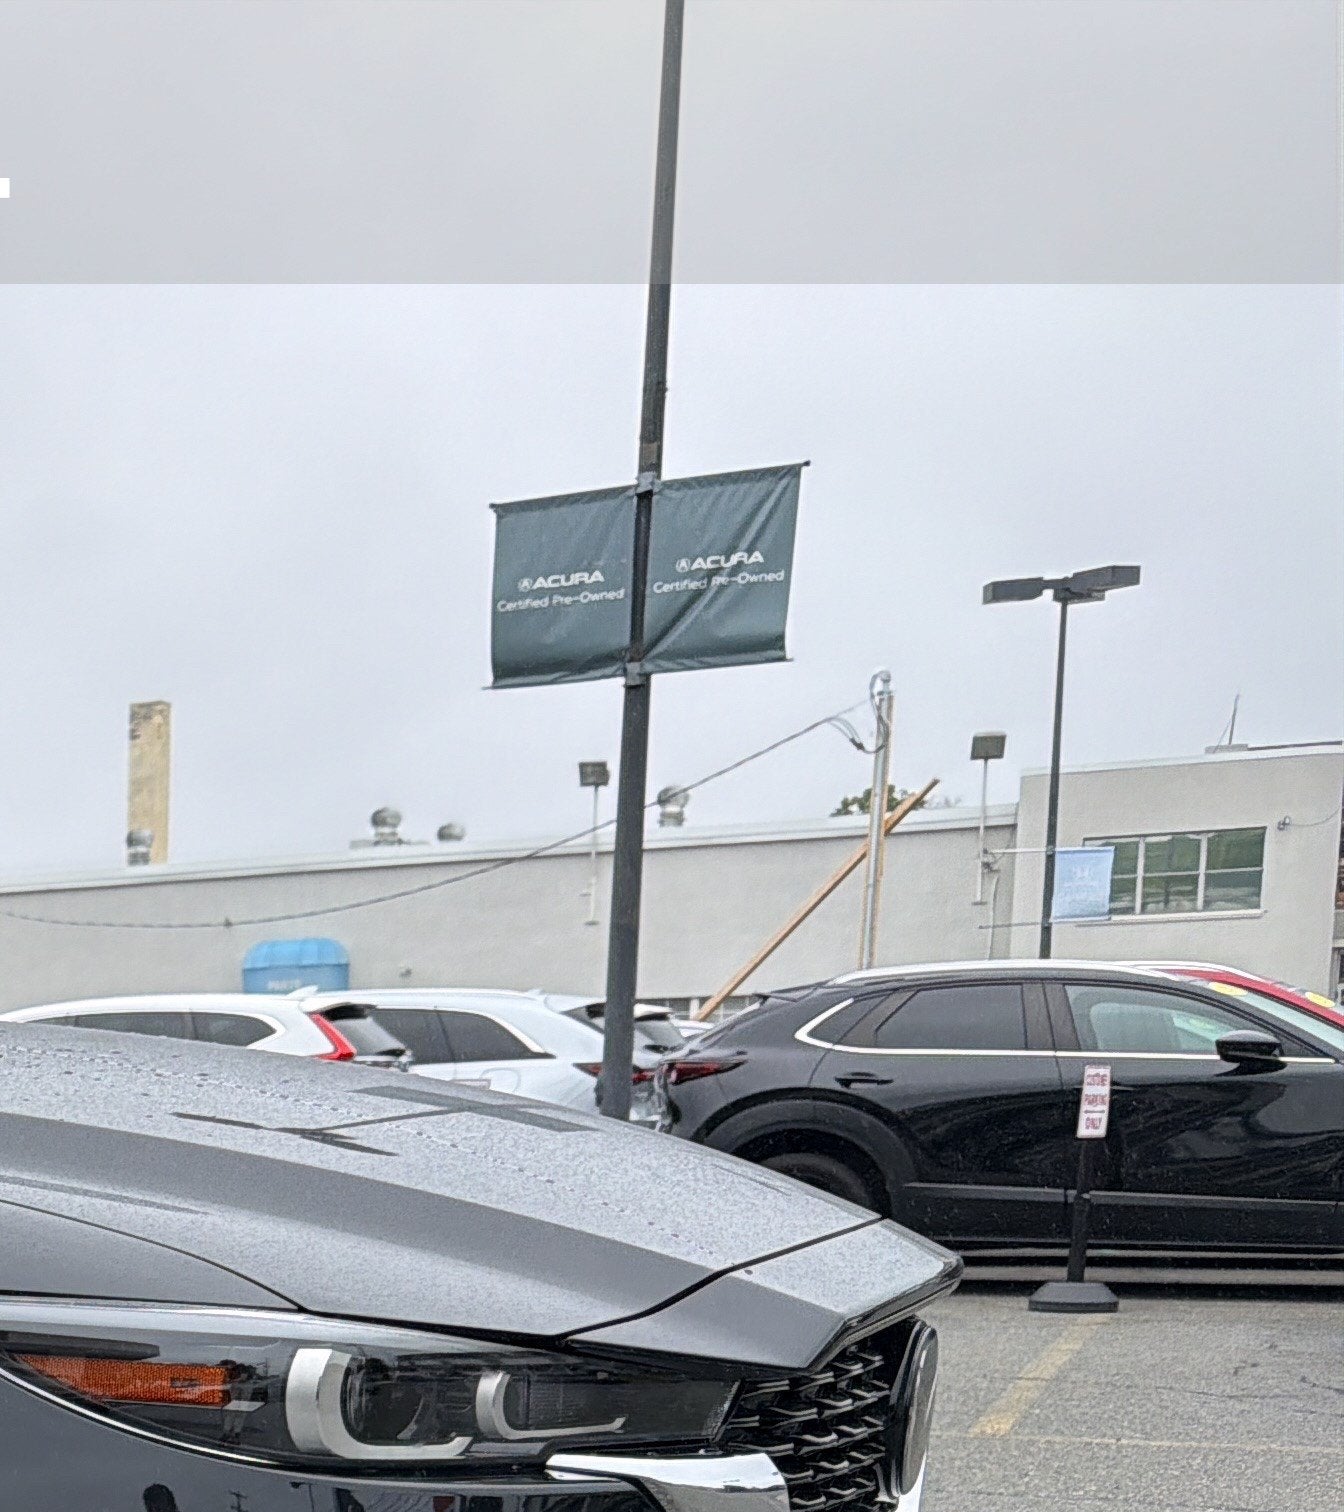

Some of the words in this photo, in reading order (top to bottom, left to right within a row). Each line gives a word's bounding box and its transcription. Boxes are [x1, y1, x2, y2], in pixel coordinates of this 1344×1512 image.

[690, 550, 765, 571] ACURA
[531, 570, 605, 590] ACURA
[652, 577, 708, 594] Certified
[710, 569, 785, 588] Pre-Owned
[496, 596, 550, 612] Certified
[552, 586, 626, 606] Pre-Owned
